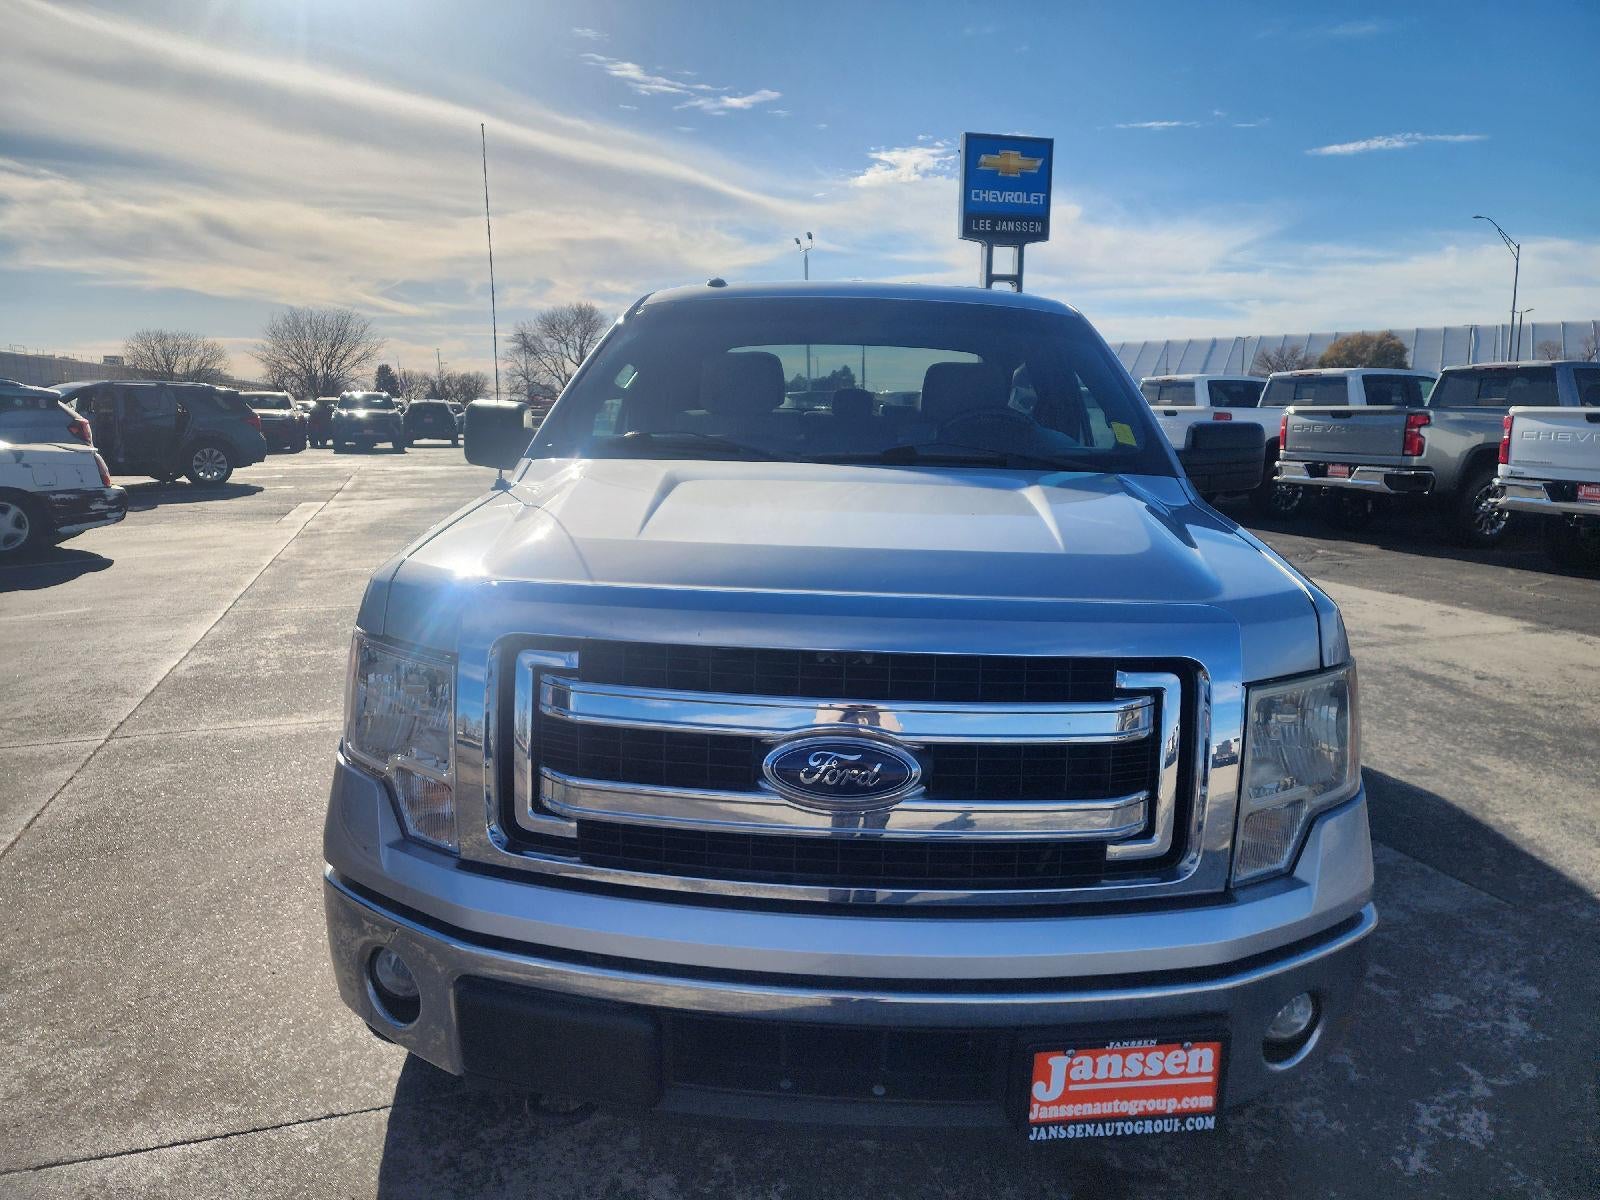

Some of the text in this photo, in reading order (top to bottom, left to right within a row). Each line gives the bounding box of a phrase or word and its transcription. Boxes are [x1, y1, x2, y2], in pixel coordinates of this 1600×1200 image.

[971, 189, 1046, 205] CHEVROLET
[972, 219, 1042, 233] LEE JANSSEN
[799, 751, 882, 786] Ford
[1105, 1039, 1158, 1049] JANSSEN
[1029, 1116, 1216, 1141] JANSSENAUTOGROUP.COM
